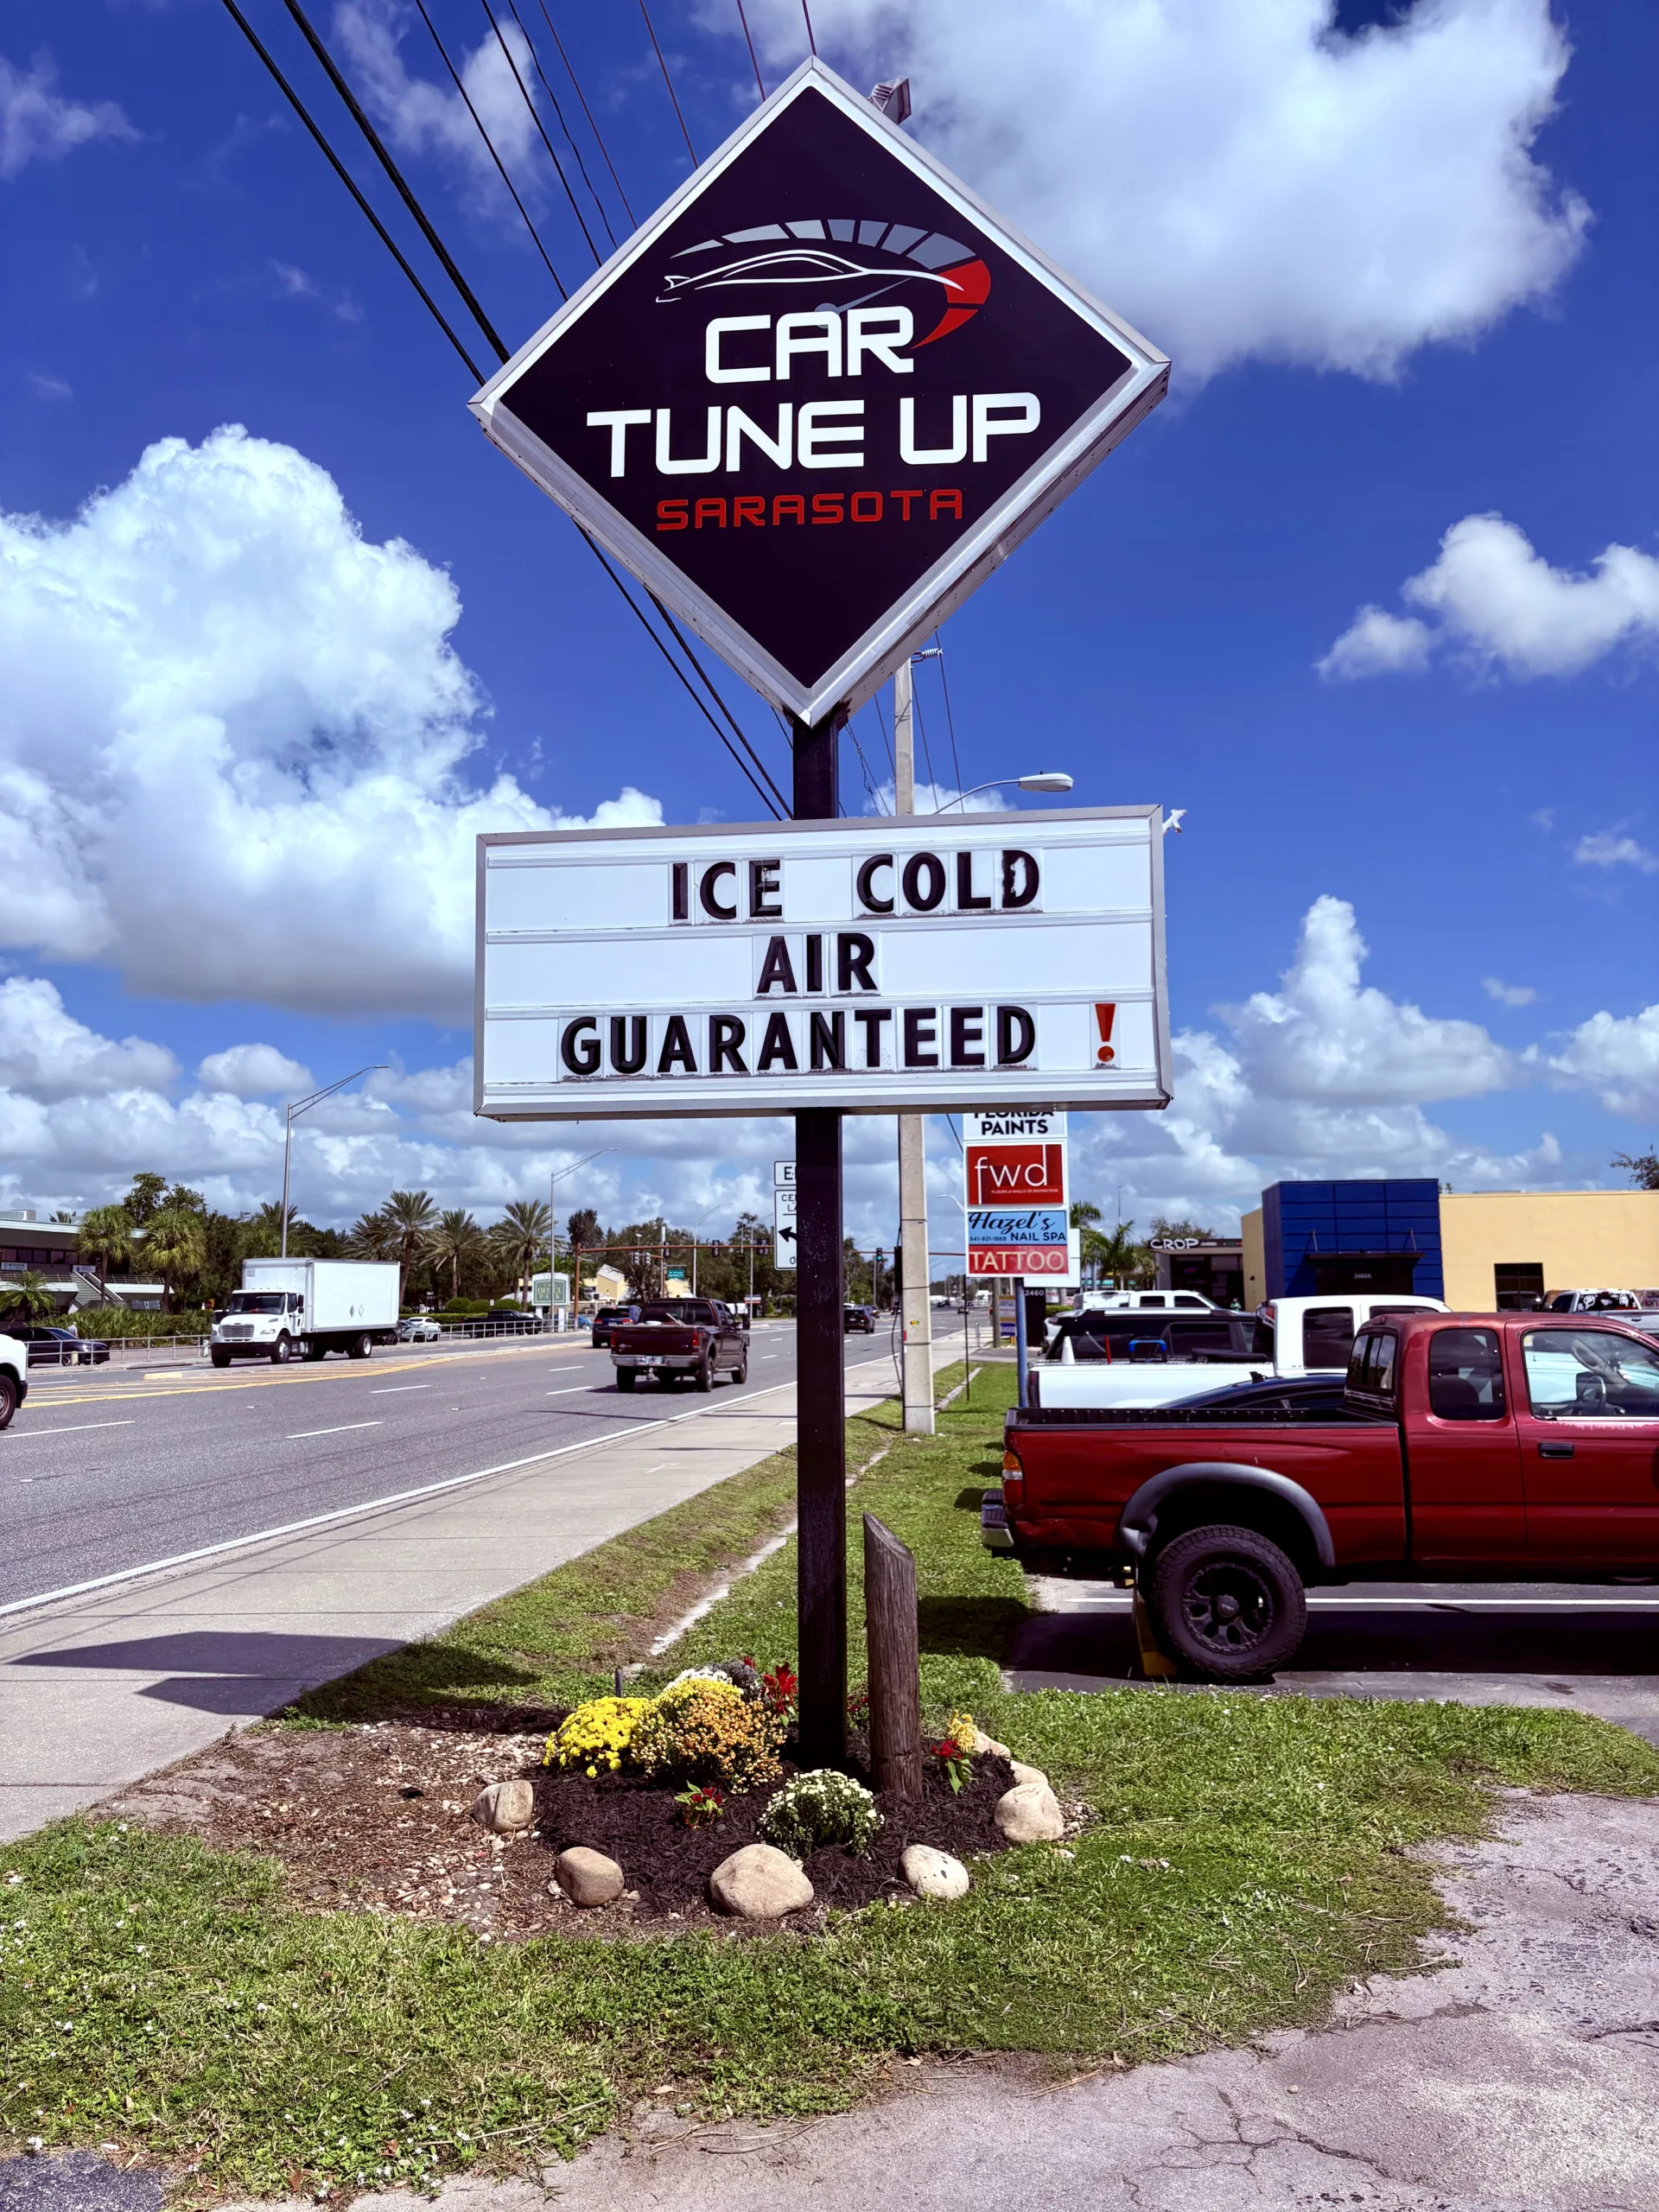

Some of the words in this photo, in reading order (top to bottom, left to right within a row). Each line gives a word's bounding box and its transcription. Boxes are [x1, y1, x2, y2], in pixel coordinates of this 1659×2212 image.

[705, 307, 914, 384] CAR
[587, 400, 865, 478] TUNE
[899, 392, 1041, 464] UP
[657, 489, 963, 531] SARASOTA
[672, 859, 781, 919] ICE
[857, 849, 1039, 913] COLD
[757, 933, 877, 994] AIR
[561, 1006, 1036, 1076] GUARANTEED
[1095, 1003, 1116, 1062] !
[982, 1120, 1048, 1135] PAINTS
[784, 1166, 797, 1180] E
[975, 1144, 1047, 1205] fwd
[969, 1211, 1056, 1235] Hazel's
[1010, 1231, 1039, 1242] NAIL
[1043, 1231, 1066, 1242] SPA
[1150, 1238, 1199, 1250] CROP
[969, 1251, 1065, 1271] TATTOO
